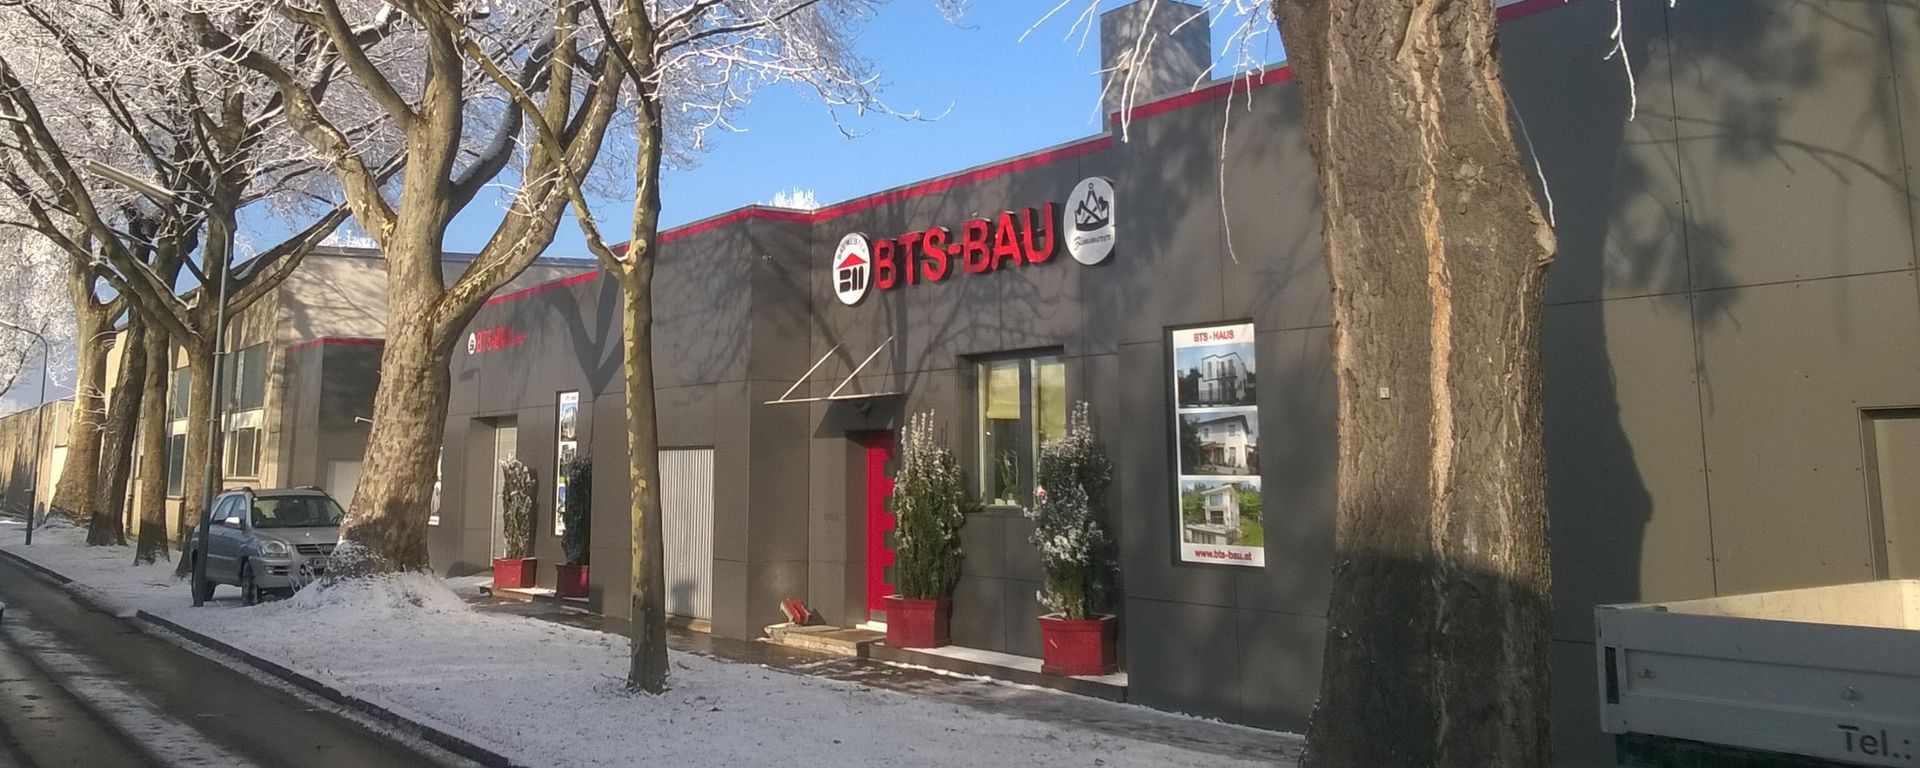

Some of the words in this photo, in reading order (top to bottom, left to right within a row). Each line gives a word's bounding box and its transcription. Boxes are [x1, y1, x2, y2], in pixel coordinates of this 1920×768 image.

[874, 202, 1055, 289] BTS-BAU
[1194, 332, 1208, 342] BTS
[1213, 330, 1234, 340] HAUS
[1194, 549, 1252, 560] www.bts-bau.at
[1837, 724, 1912, 760] Tel.:
